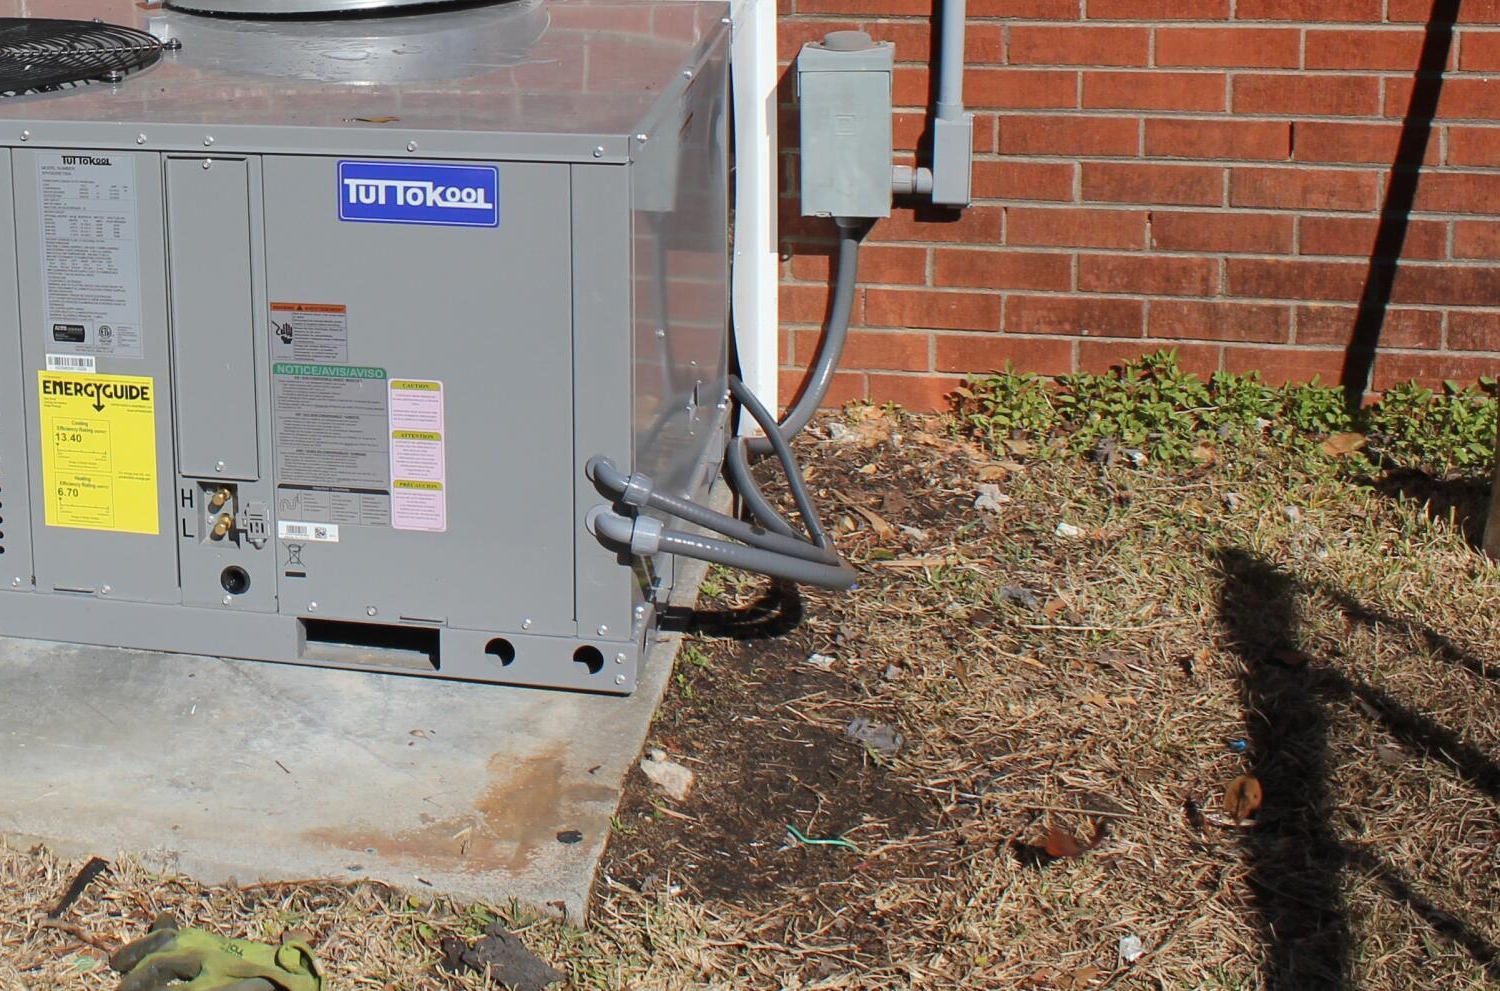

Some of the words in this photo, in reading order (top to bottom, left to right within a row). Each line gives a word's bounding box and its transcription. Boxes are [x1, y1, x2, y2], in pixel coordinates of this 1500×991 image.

[277, 364, 384, 378] NOTICE/AVIS/AVISO
[42, 380, 150, 401] ENERGYGUIDE
[55, 433, 82, 443] 13.40
[57, 487, 79, 497] 6.70
[181, 488, 193, 508] H
[182, 518, 194, 537] L
